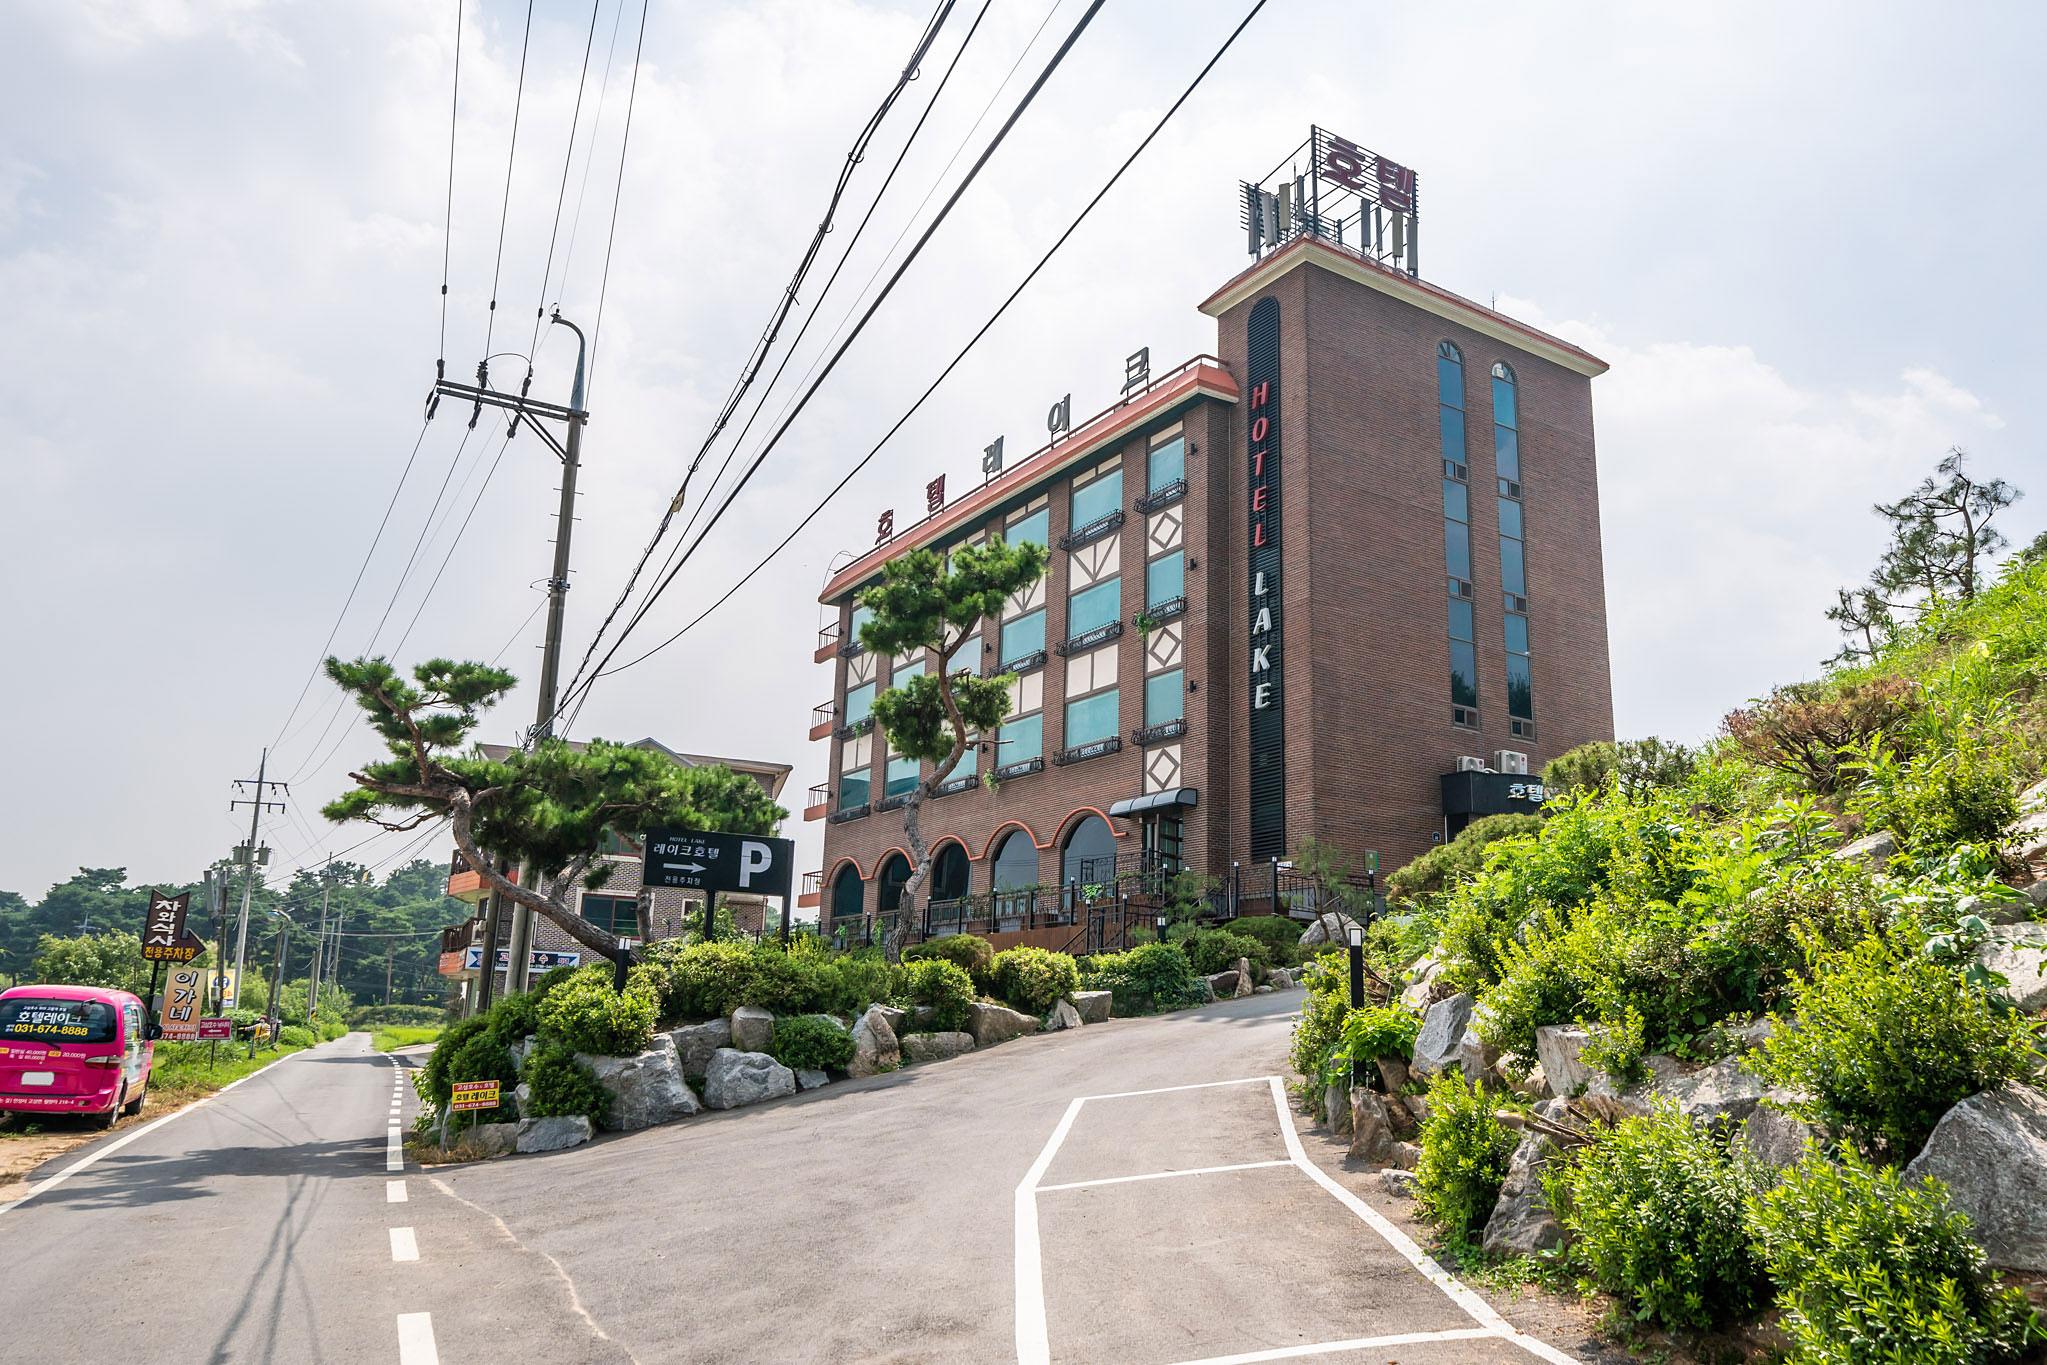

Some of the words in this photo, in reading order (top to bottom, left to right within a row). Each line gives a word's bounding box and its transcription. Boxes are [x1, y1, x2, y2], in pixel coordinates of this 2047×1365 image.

[1320, 136, 1414, 212] 호텔
[1251, 380, 1269, 547] HOTEL
[1253, 571, 1272, 710] LAKE
[1507, 783, 1543, 802] 호텔
[739, 841, 772, 888] P
[145, 946, 194, 960] 전용주차장
[169, 971, 199, 1022] 이가네
[14, 1024, 88, 1036] 031-674-8888
[471, 1091, 496, 1101] 레이크
